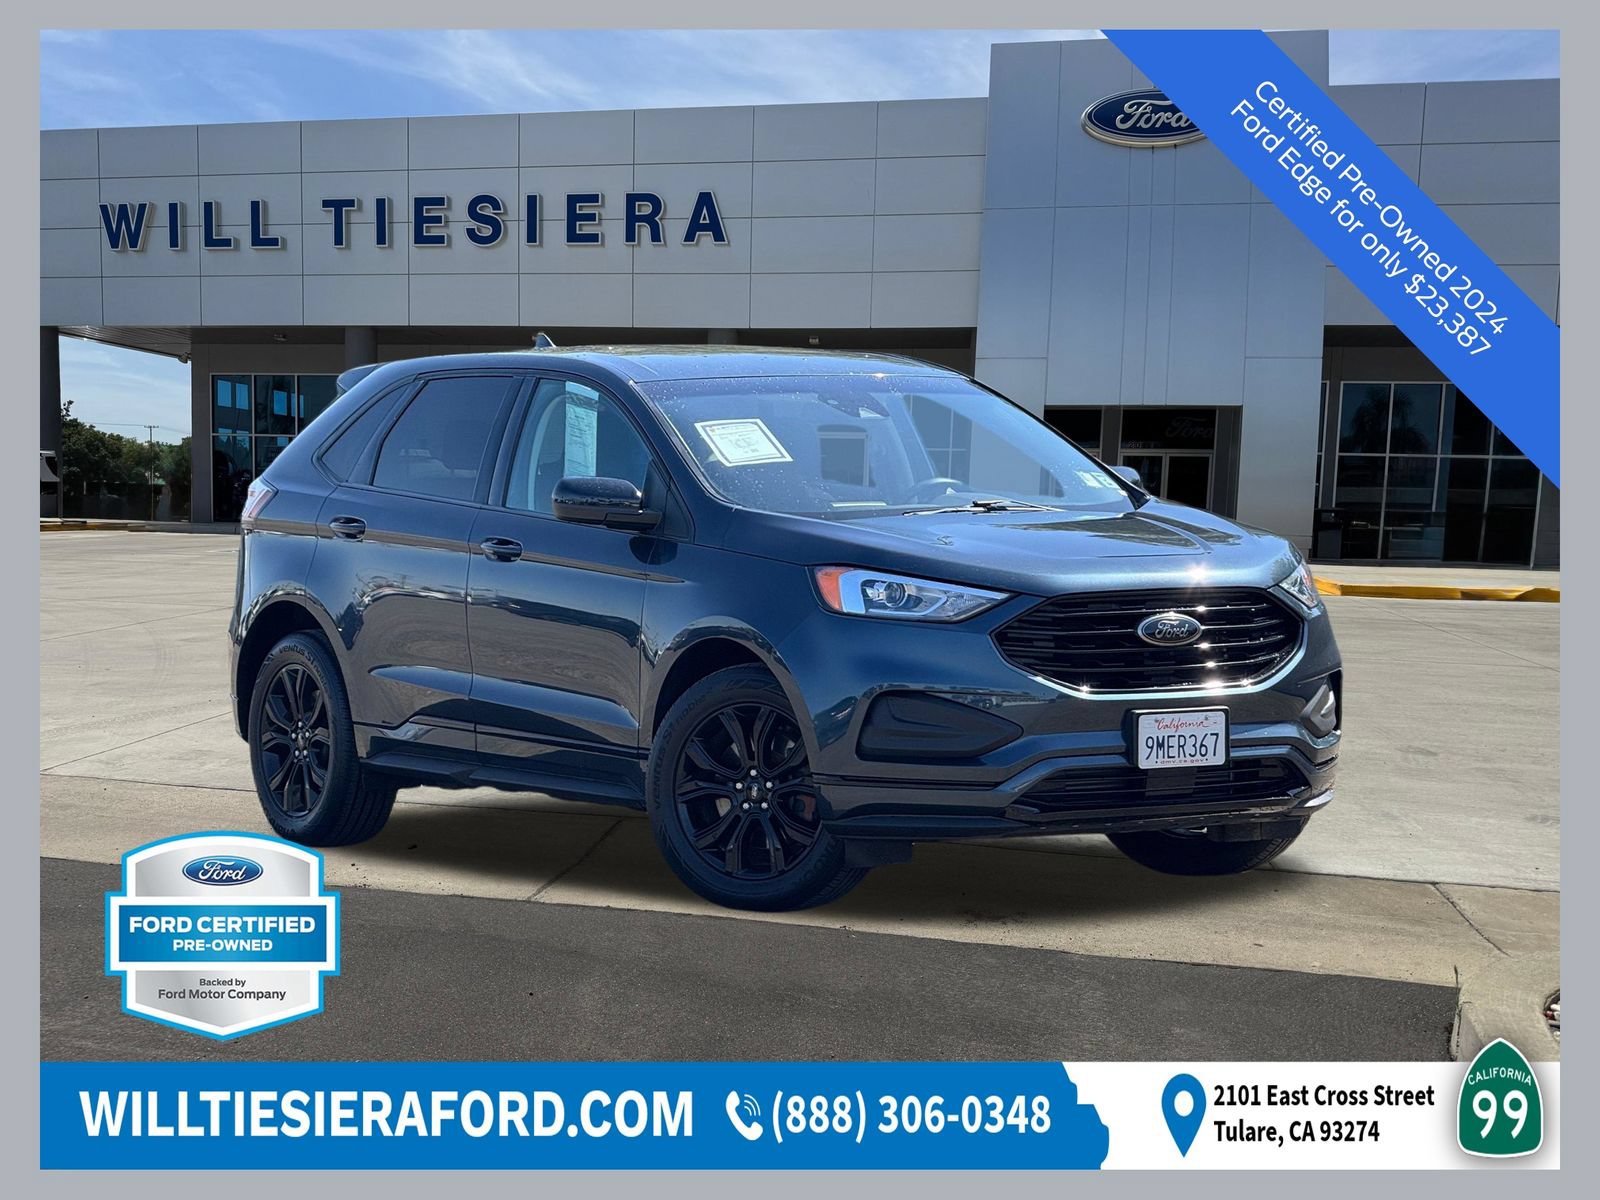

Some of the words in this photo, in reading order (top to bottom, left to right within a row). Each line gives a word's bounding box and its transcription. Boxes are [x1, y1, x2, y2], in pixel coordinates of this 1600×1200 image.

[99, 199, 283, 250] WILL
[320, 190, 729, 249] TIESIERA
[1155, 619, 1189, 638] Ford
[1156, 716, 1209, 733] California
[1145, 732, 1220, 760] 9MER367
